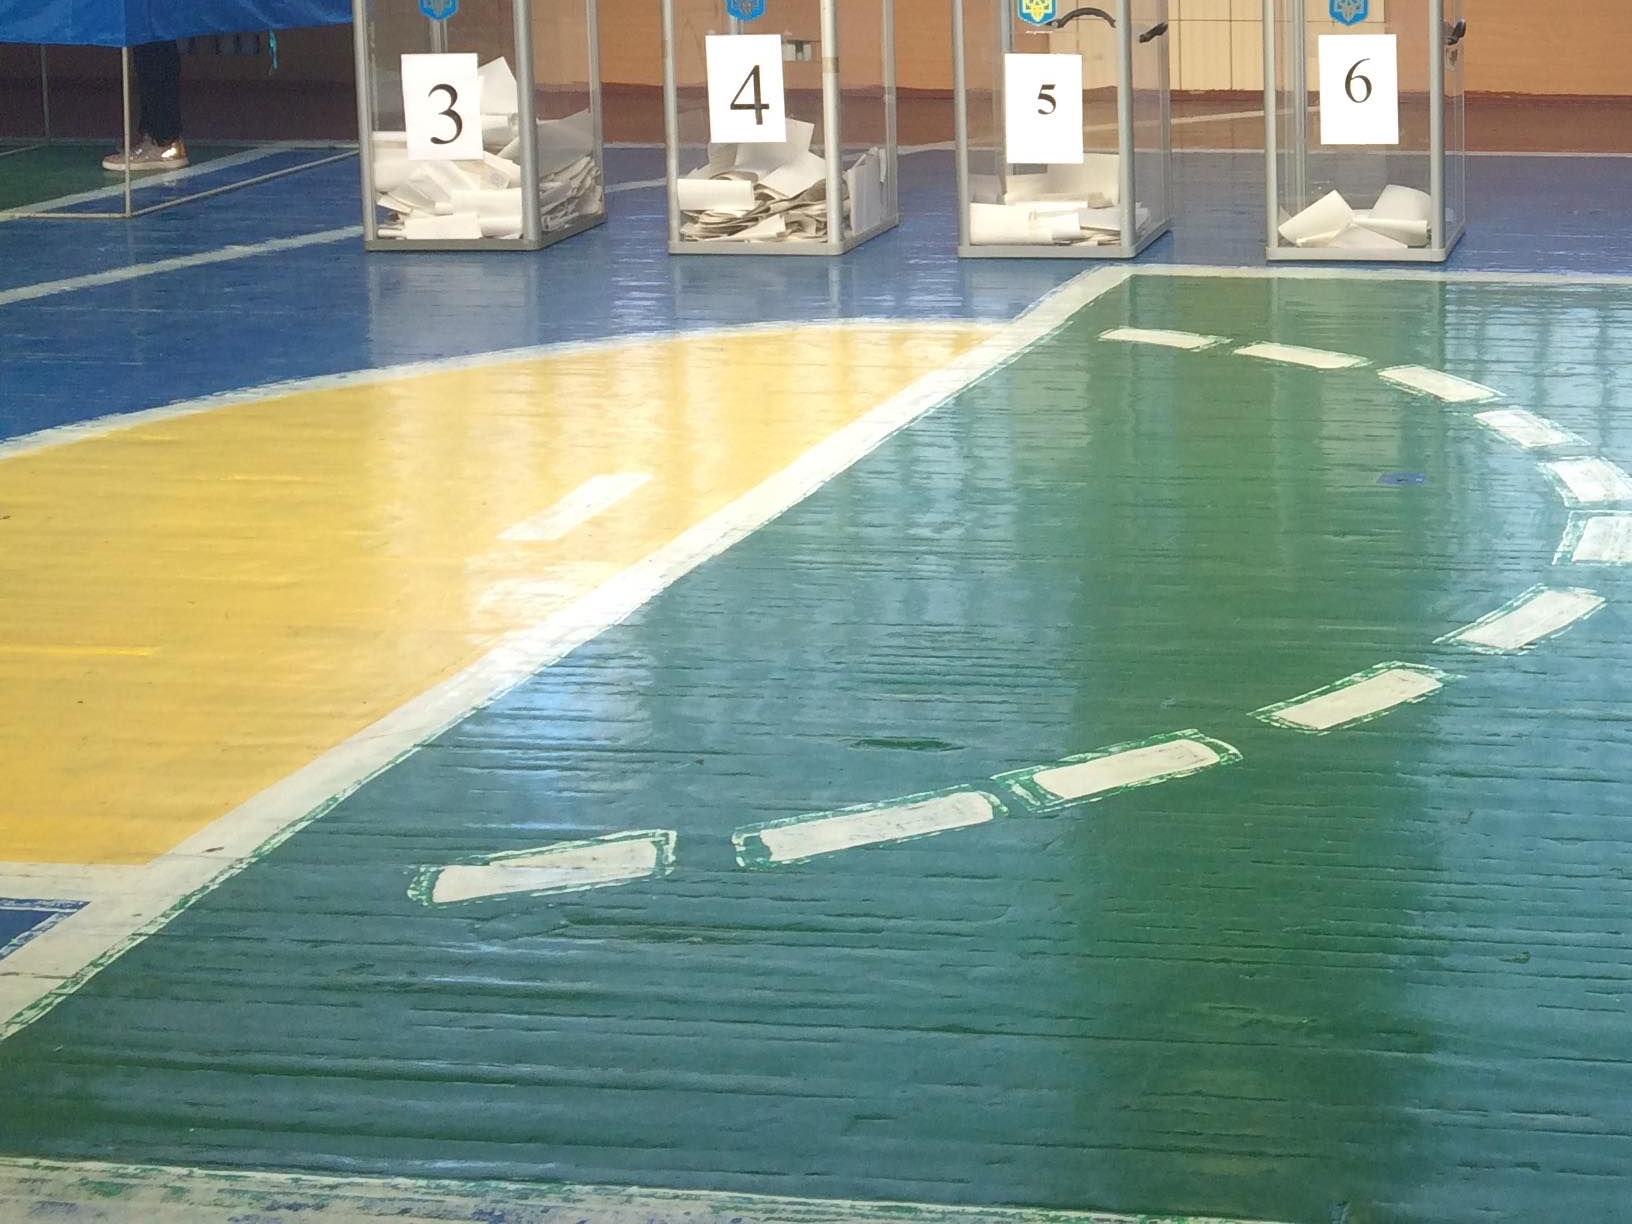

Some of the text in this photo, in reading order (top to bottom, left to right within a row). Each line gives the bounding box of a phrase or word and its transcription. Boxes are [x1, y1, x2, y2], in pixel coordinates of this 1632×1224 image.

[730, 64, 770, 125] 4
[1037, 84, 1057, 115] 5
[1344, 58, 1372, 103] 6
[428, 83, 463, 145] 3
